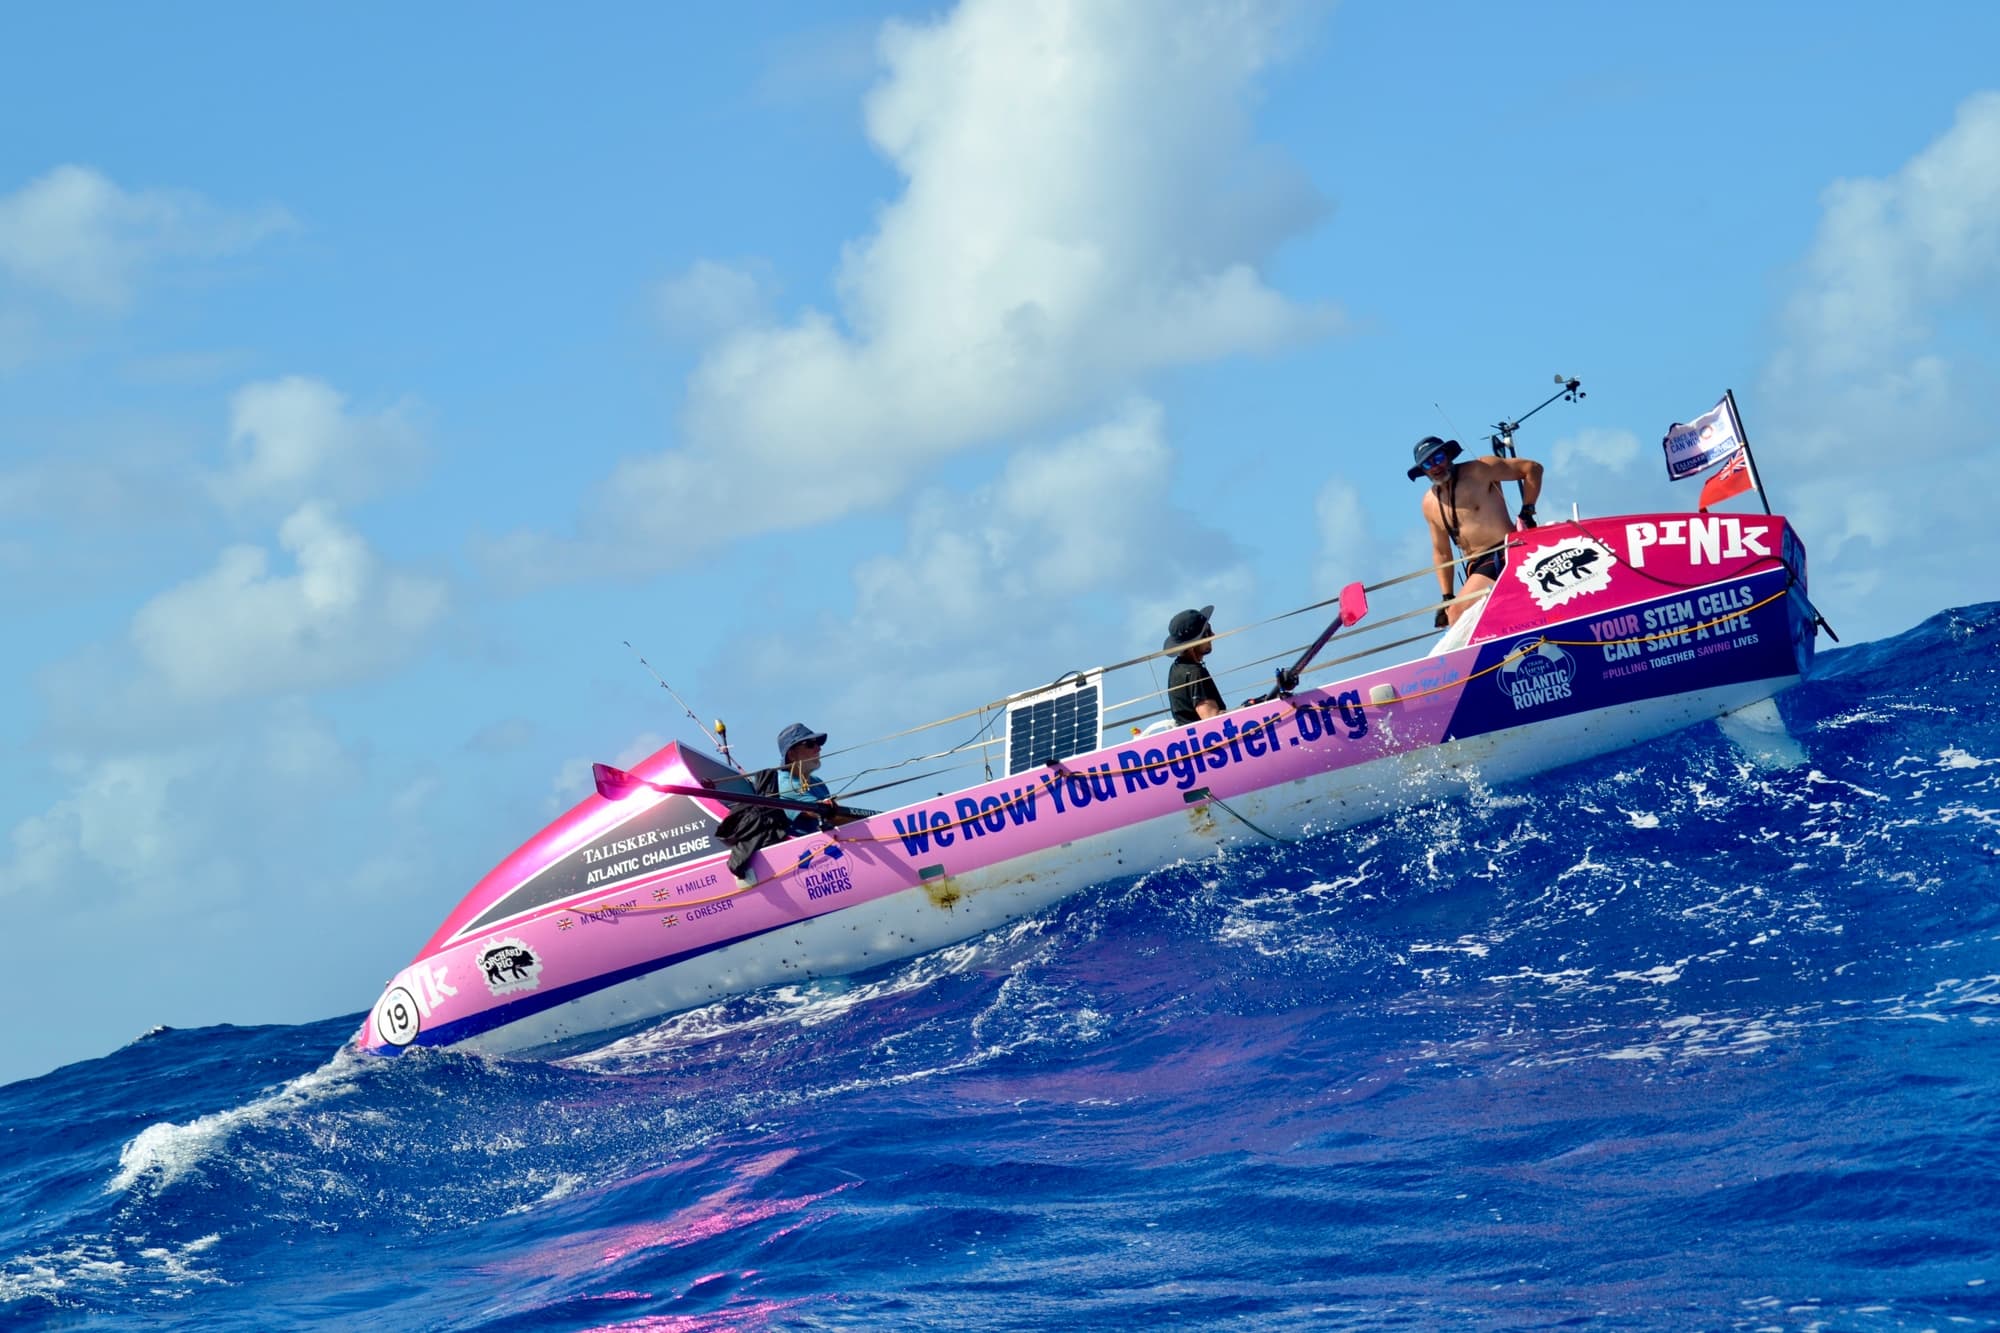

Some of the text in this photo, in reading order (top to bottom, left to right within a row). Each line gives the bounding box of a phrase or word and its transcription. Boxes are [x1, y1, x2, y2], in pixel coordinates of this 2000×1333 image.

[1535, 548, 1584, 581] ORCHARD
[1552, 560, 1573, 577] PIG
[1589, 586, 1754, 642] YOUR STEM CELLS
[1603, 611, 1751, 662] CAN SAVE A LIFE
[1602, 634, 1759, 680] #PULLING TOGETHER SAVING LIVES
[1511, 669, 1569, 696] ATLANTIC
[1513, 682, 1572, 710] ROWERS
[893, 810, 955, 857] We
[955, 784, 1037, 840] Row
[1040, 762, 1117, 814] You
[583, 819, 707, 864] TALISKER WHISKY
[586, 836, 711, 884] ATLANTIC CHALLENGE
[676, 874, 718, 896] H MILLER
[805, 866, 848, 887] ATLANTIC
[807, 877, 852, 900] ROWERS
[580, 900, 637, 925] M BEAUMONT
[686, 899, 734, 922] G DRESSER
[484, 948, 523, 971] ORCHARD
[498, 957, 514, 972] PIG
[386, 1003, 409, 1034] 19
